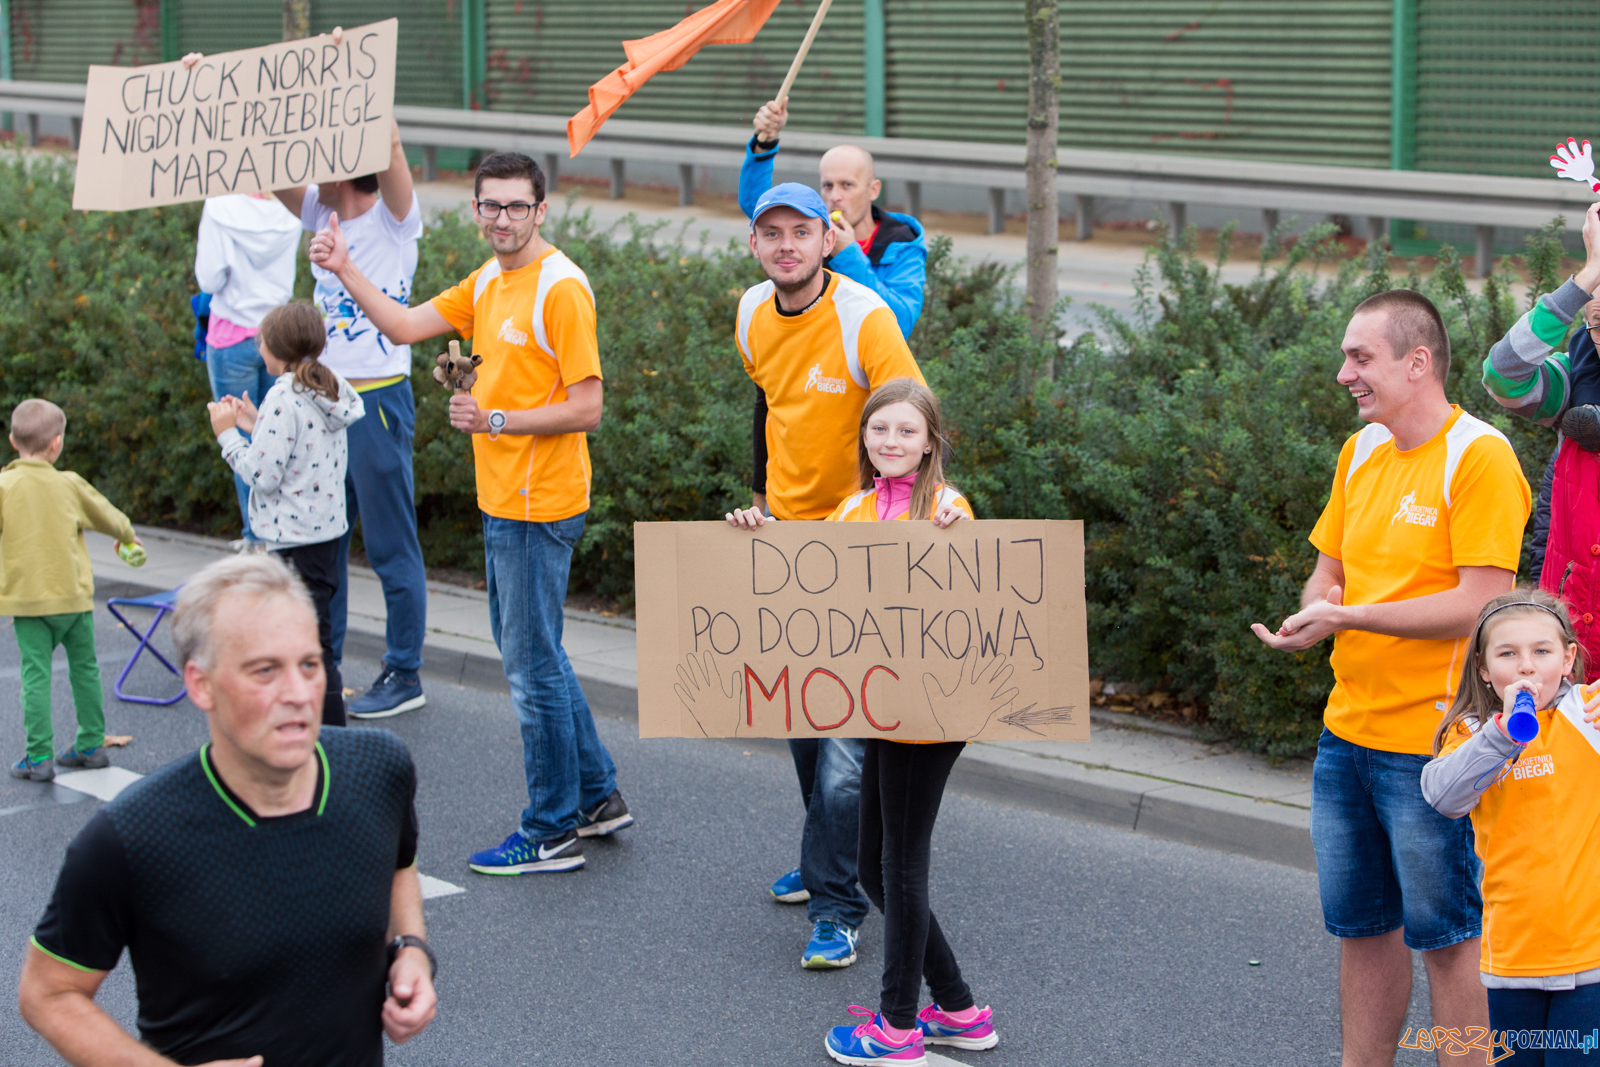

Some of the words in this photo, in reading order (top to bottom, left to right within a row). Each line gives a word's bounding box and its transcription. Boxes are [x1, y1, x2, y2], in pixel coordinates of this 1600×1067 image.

[122, 60, 243, 114] CHUCK
[257, 33, 379, 94] NORRIS
[102, 108, 185, 155] NIGDY
[192, 100, 238, 145] NIE
[241, 82, 382, 137] PRZEBIEGŁ
[150, 127, 365, 198] MARATONU
[752, 538, 1044, 604] DOTKNIJ
[692, 606, 741, 655] PO
[758, 607, 1044, 672] DODATKOWĄ
[744, 662, 901, 732] MOC
